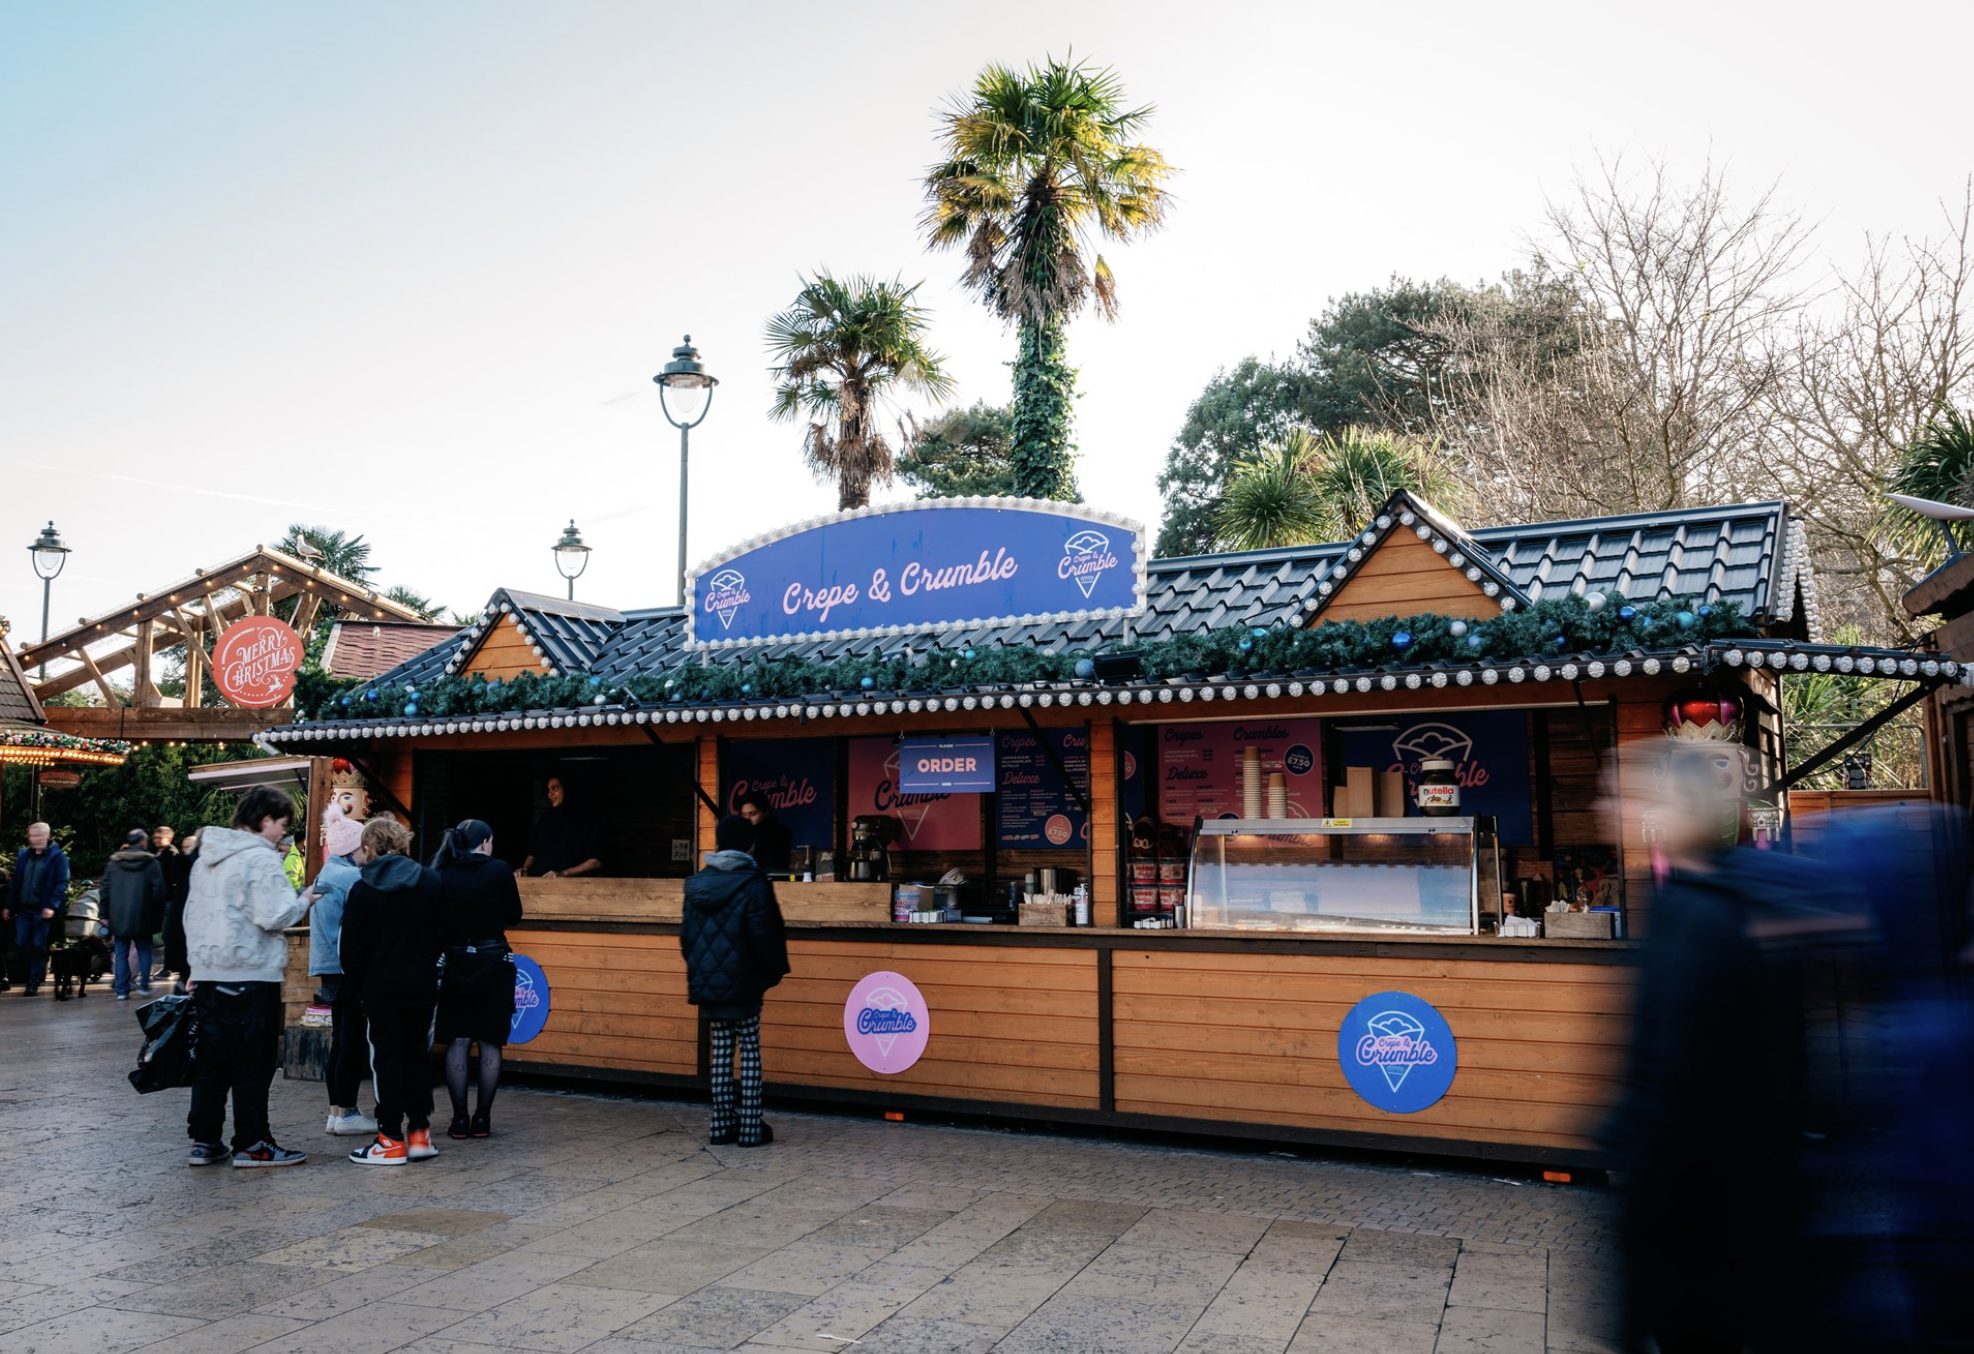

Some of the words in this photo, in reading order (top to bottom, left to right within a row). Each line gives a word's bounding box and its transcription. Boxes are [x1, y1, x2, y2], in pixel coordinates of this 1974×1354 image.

[1057, 552, 1118, 579] Crumble
[782, 582, 859, 623] Crepe
[868, 568, 891, 602] &
[900, 546, 1018, 595] Crumble
[704, 589, 751, 613] Crumble
[236, 626, 288, 665] MERRY
[224, 646, 296, 692] CHRISTMAS
[1001, 734, 1037, 752] Crepes
[1164, 727, 1204, 747] Crepes
[1232, 725, 1290, 742] Crumbles
[917, 757, 977, 773] ORDER
[1287, 757, 1310, 767] £7.50
[751, 779, 777, 795] Crepe
[779, 774, 788, 787] &
[1423, 786, 1454, 795] nutella
[728, 777, 817, 816] Cmble
[858, 1009, 915, 1033] Crumble
[1357, 1036, 1437, 1063] Crumble
[1379, 1038, 1401, 1050] Crepe
[1403, 1037, 1411, 1048] &
